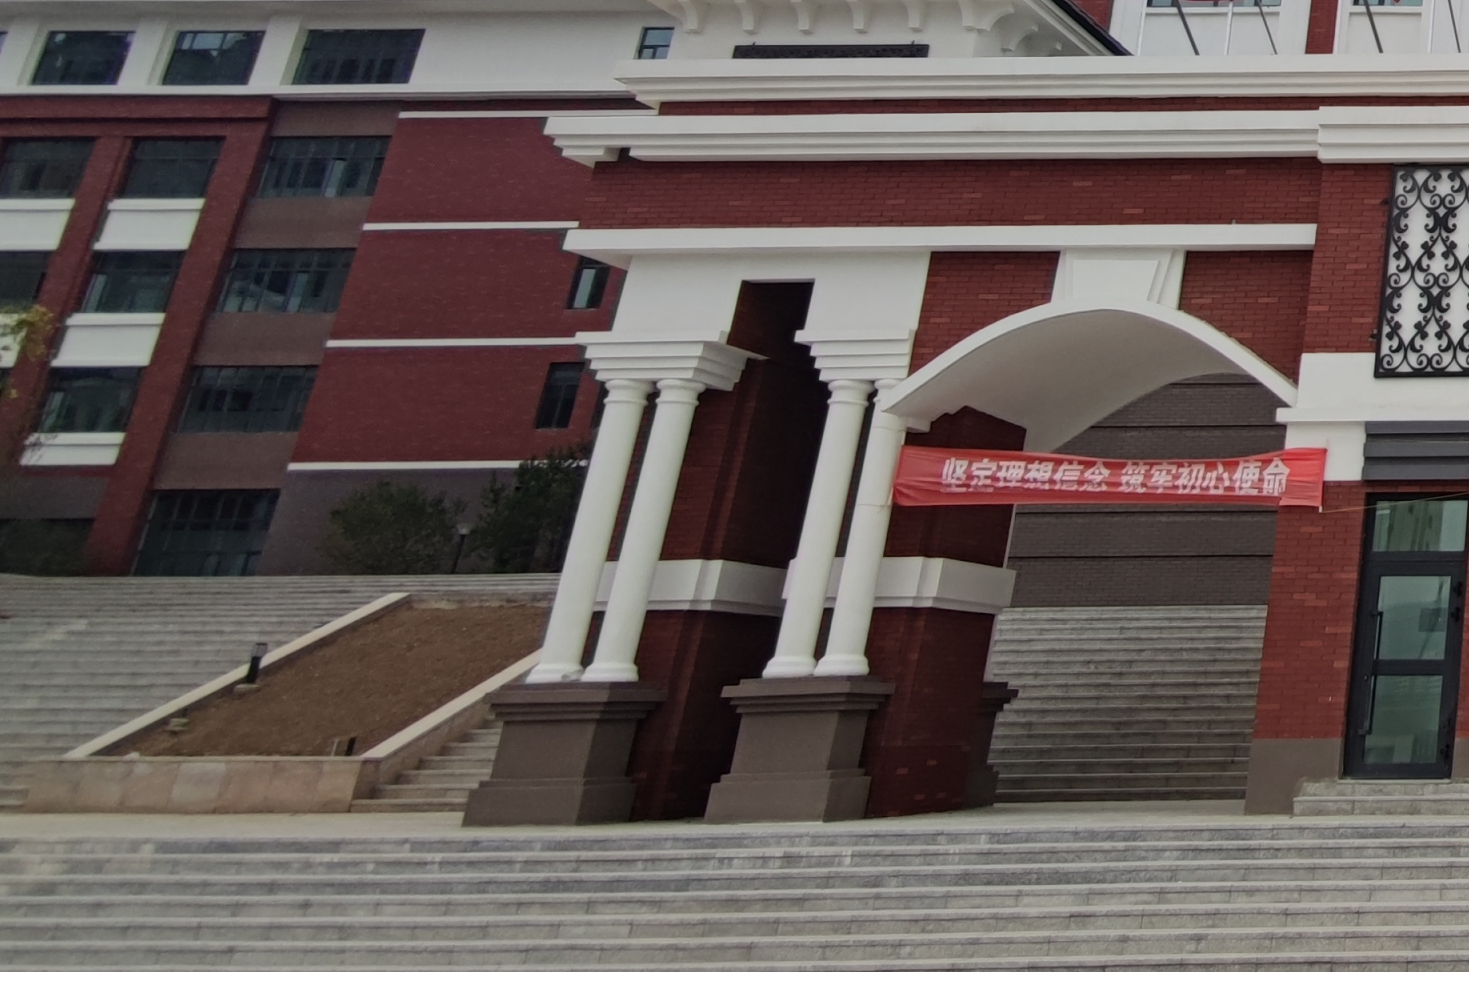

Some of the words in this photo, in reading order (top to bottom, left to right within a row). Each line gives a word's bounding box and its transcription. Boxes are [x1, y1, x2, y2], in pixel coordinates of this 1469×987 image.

[940, 457, 1111, 493] 坚定理想信念
[1119, 457, 1291, 496] 筑牢初心使命
